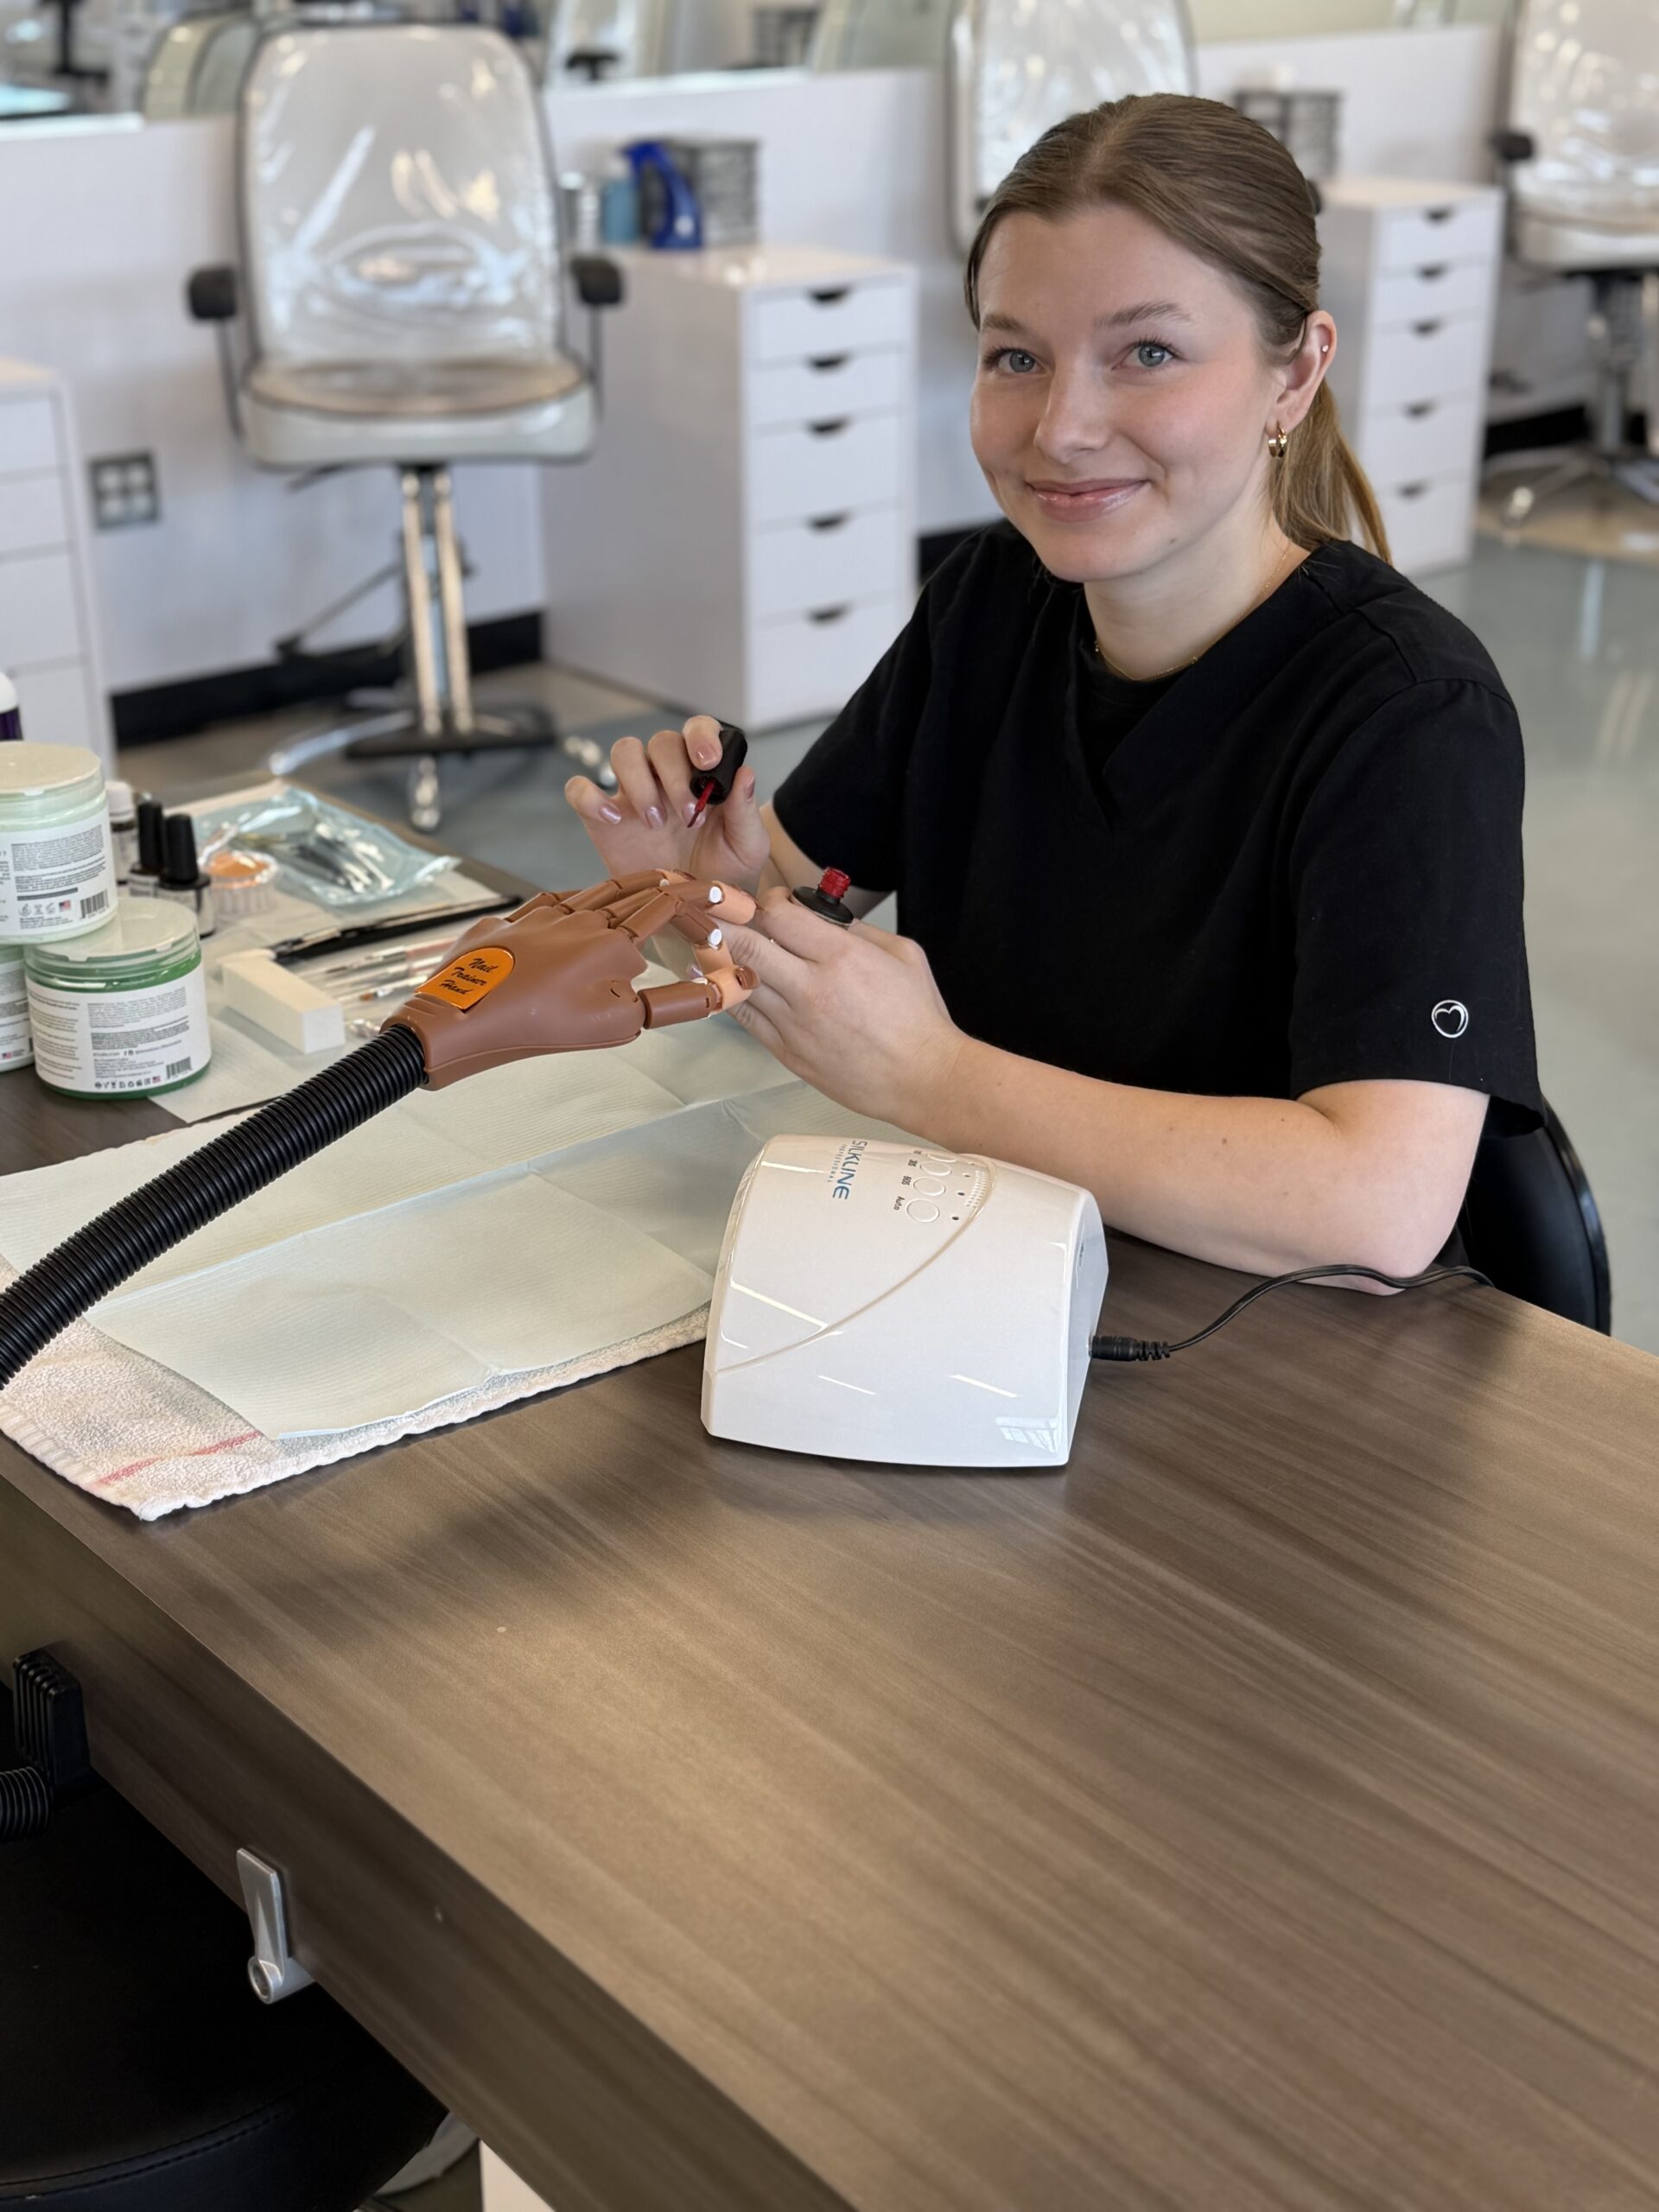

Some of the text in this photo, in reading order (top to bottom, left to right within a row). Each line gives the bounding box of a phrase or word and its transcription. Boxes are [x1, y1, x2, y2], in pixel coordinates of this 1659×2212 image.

[468, 957, 499, 973] Nail
[451, 966, 487, 986] Trainer
[439, 979, 474, 995] Hand
[832, 1140, 868, 1200] SILKLINE
[893, 1195, 906, 1211] Auto
